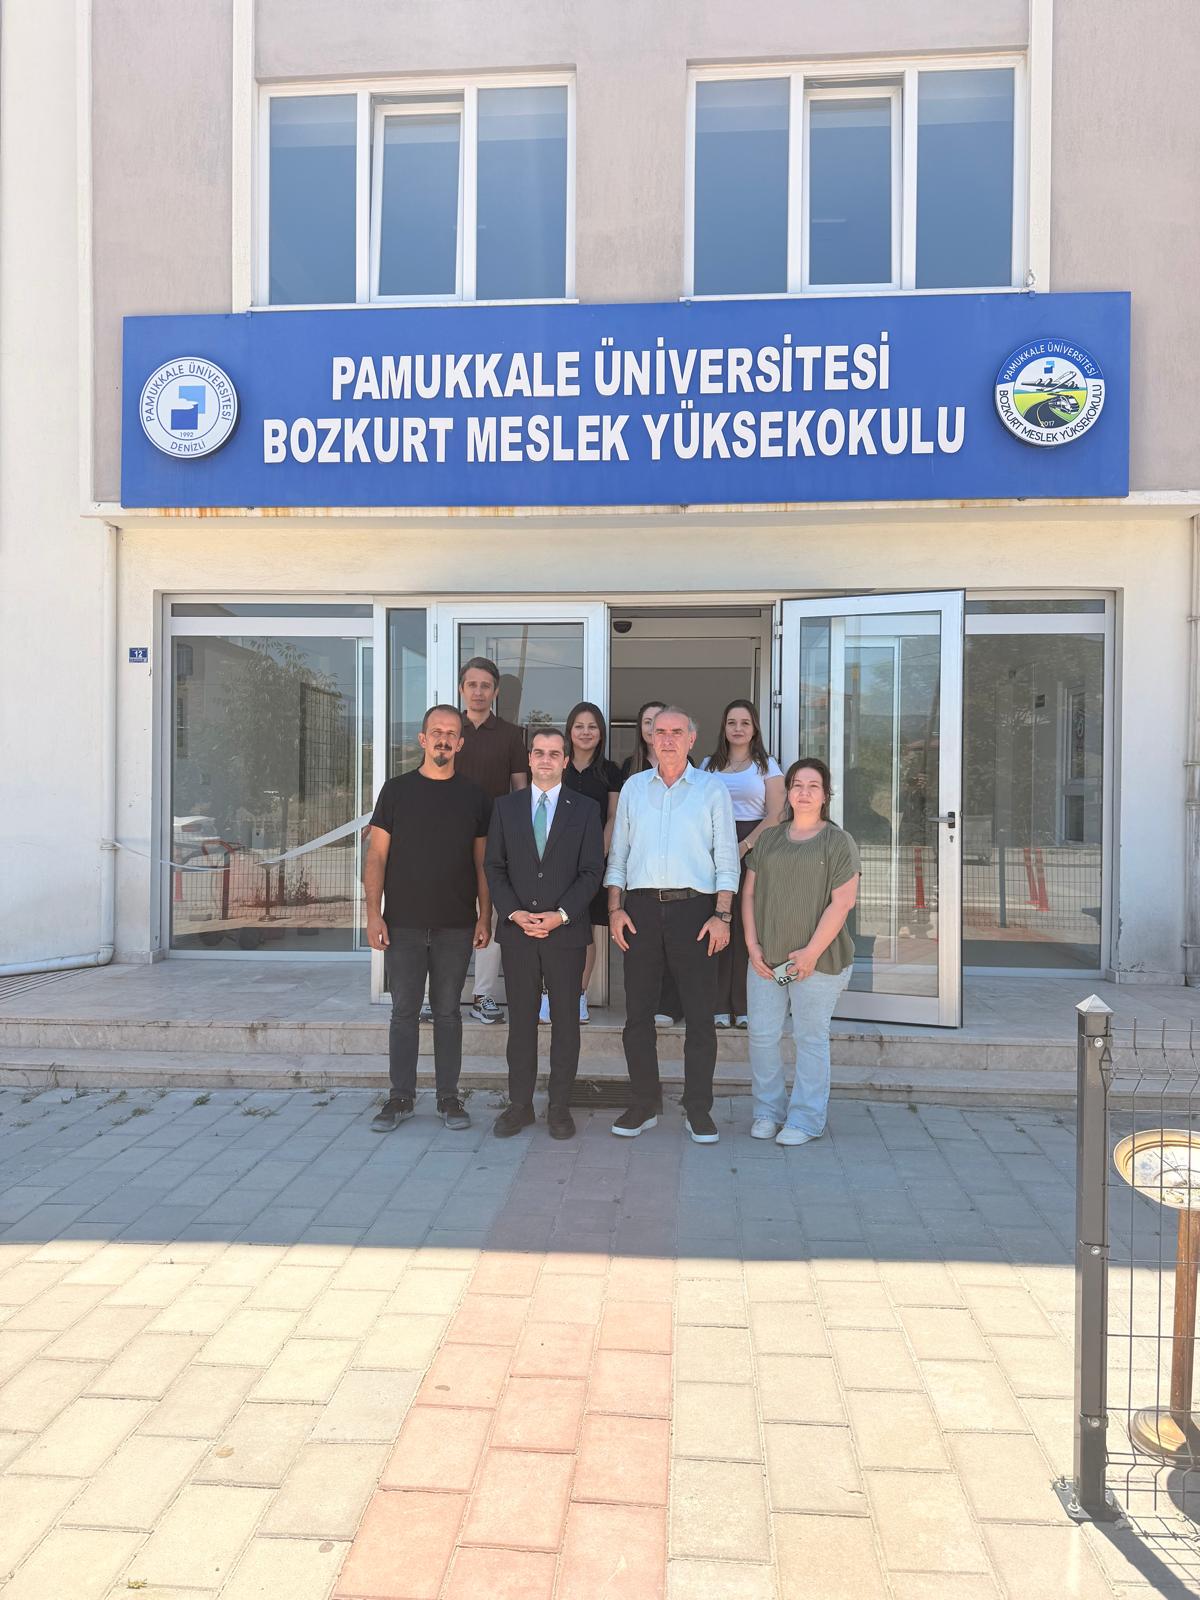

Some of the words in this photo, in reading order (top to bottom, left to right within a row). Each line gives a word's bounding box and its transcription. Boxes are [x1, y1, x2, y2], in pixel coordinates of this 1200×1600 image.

[332, 352, 580, 400] PAMUKKALE
[595, 331, 889, 396] ÜNİVERSİTESİ
[1004, 345, 1045, 380] PAMUKKALE
[1047, 342, 1098, 376] ÜNİVERSİTESİ
[145, 364, 184, 421] PAMUKKALE
[188, 361, 233, 421] ÜNİVERSİTESİ
[999, 389, 1024, 430] BOZKURT
[1021, 426, 1059, 442] MESLEK
[1059, 384, 1102, 440] YÜKSEKOKULU
[170, 439, 206, 452] DENİZLİ
[263, 417, 454, 464] BOZKURT
[467, 414, 630, 463] MESLEK
[642, 400, 965, 460] YÜKSEKOKULU
[134, 650, 143, 658] 12
